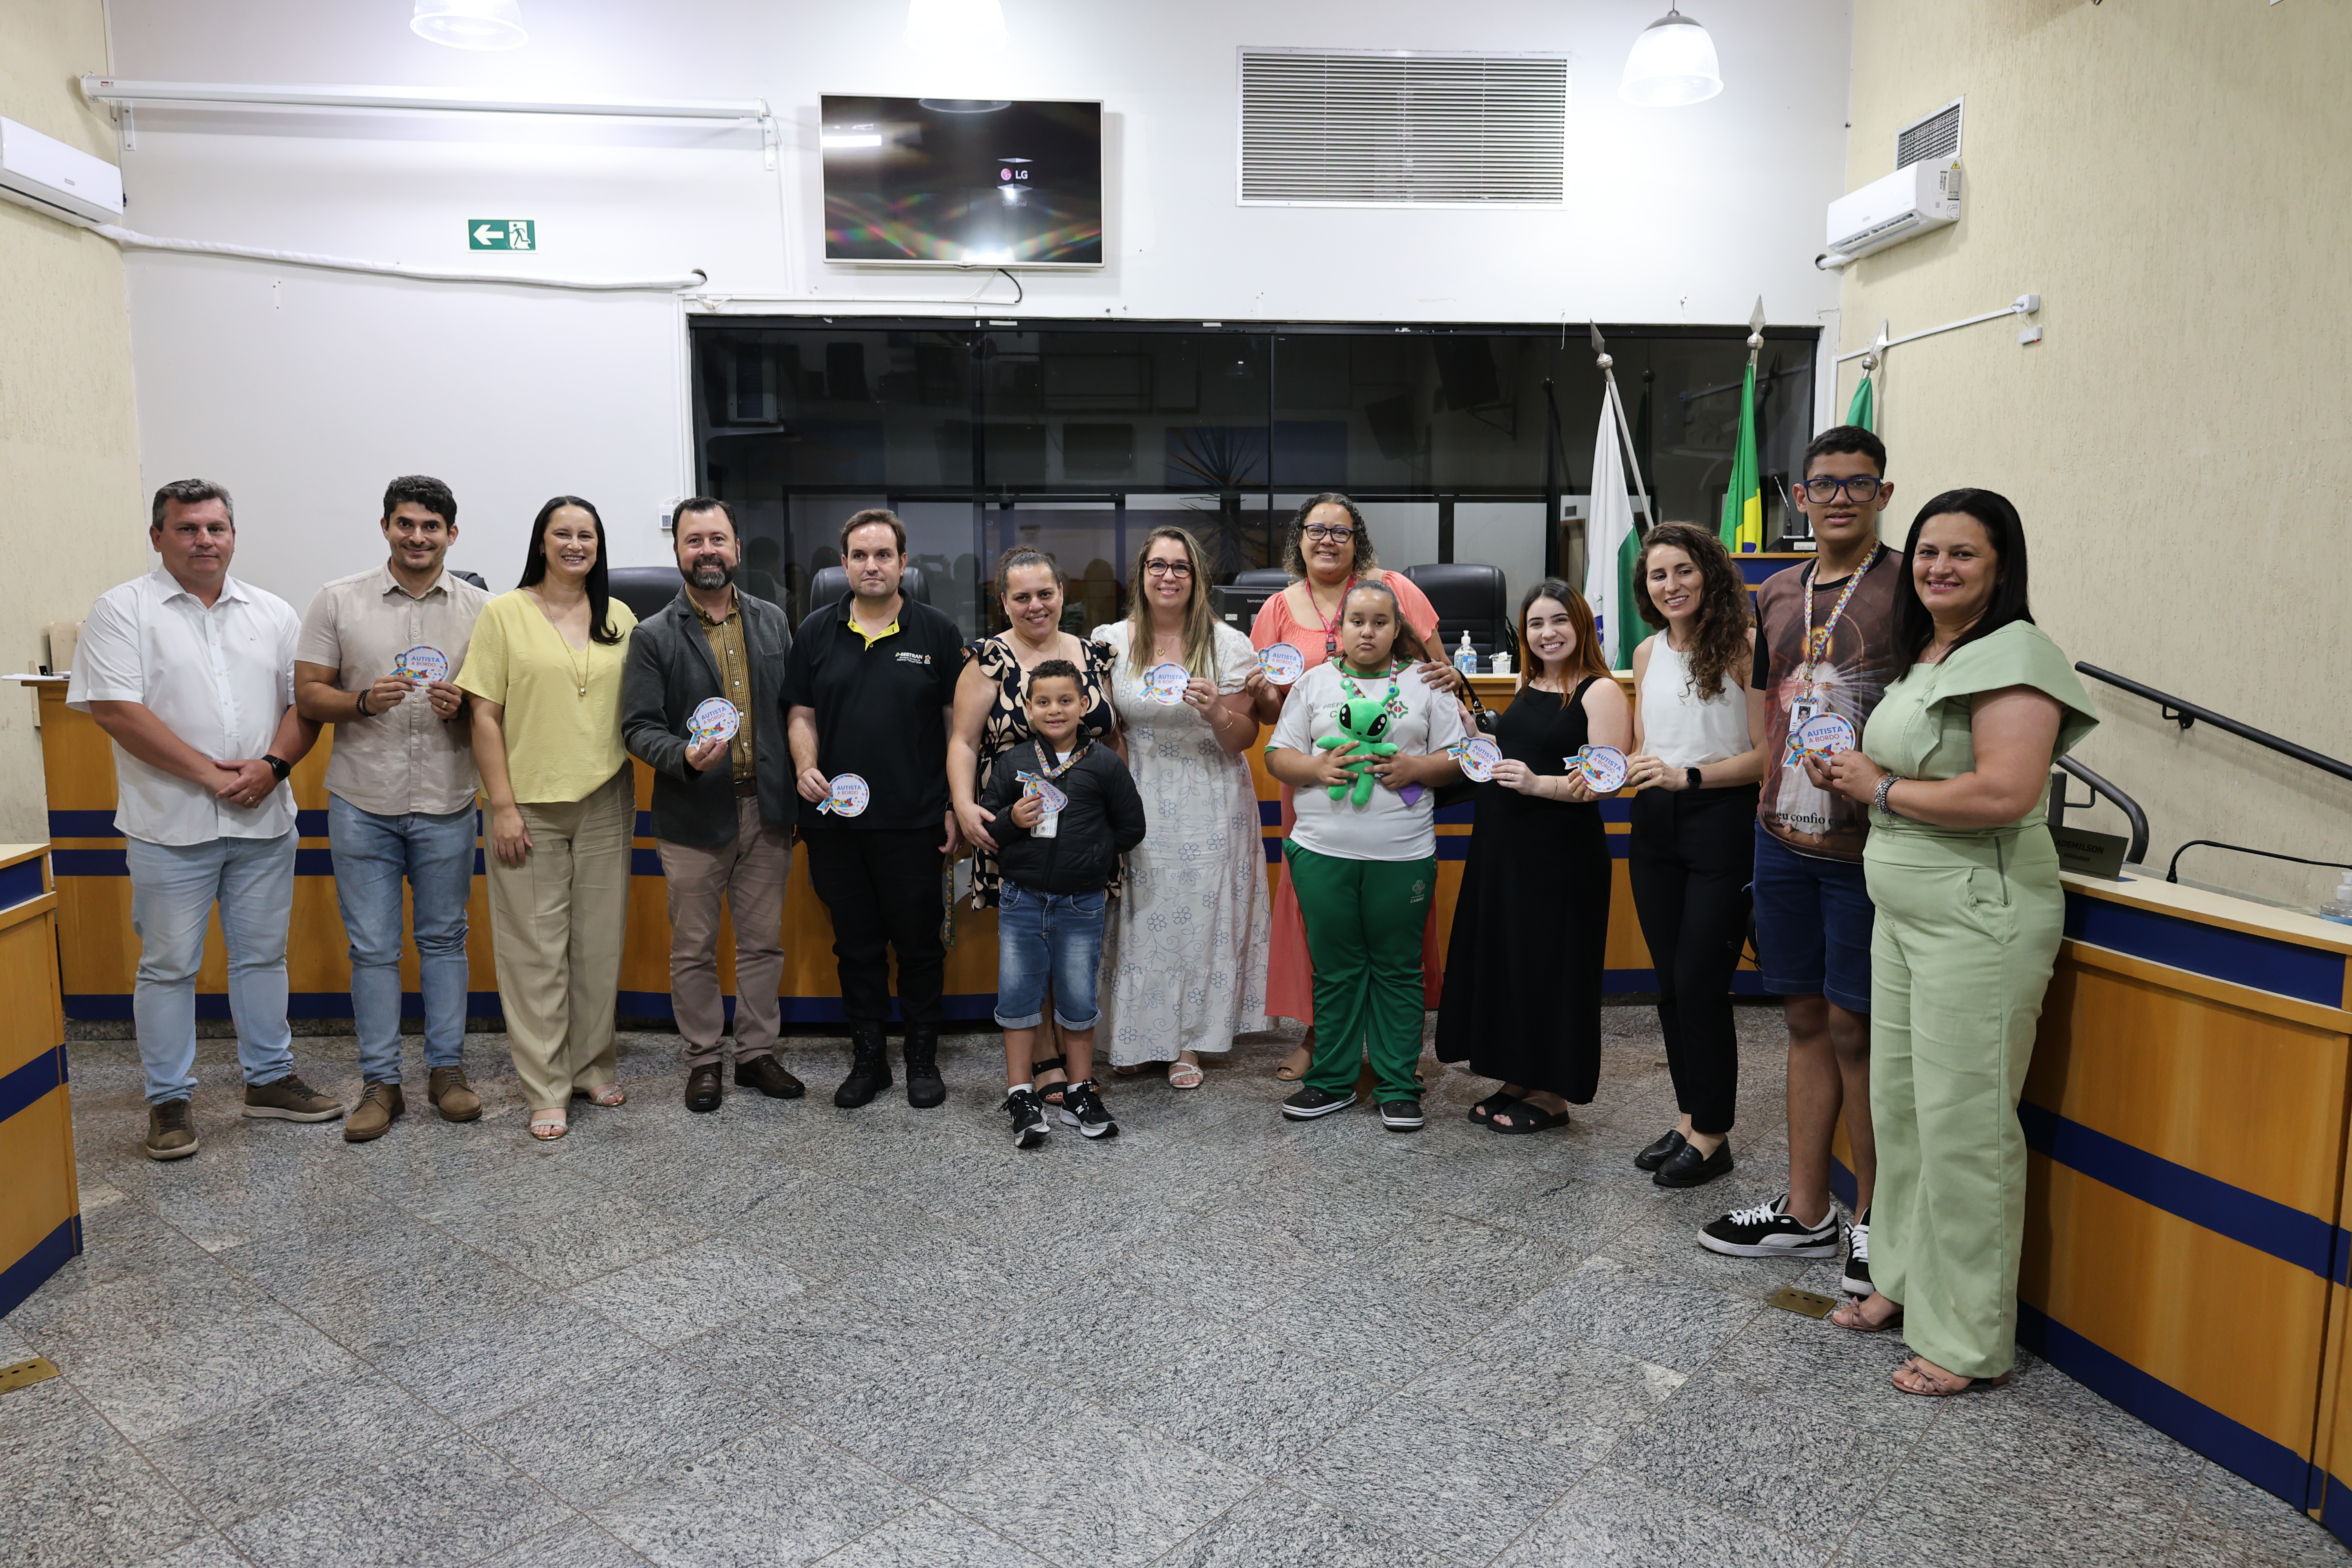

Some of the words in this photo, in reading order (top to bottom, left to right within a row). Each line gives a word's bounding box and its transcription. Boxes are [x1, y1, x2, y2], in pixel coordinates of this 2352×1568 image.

[1015, 170, 1028, 179] LG
[1272, 653, 1296, 661] AUTISTA
[701, 706, 727, 720] AUTISTA
[708, 713, 725, 723] BORDO
[1807, 726, 1843, 737] AUTISTA
[1815, 733, 1840, 742] BORDO
[1474, 745, 1495, 762] AUTISTA
[1475, 751, 1490, 764] BORDO
[1596, 753, 1621, 771] AUTISTA
[1597, 760, 1615, 773] BORDO
[1043, 787, 1054, 801] BORDO
[1044, 783, 1061, 803] AUTISTA
[1791, 812, 1825, 824] confio
[2056, 839, 2104, 854] ADEMILSON
[2063, 853, 2090, 862] VEREADOR
